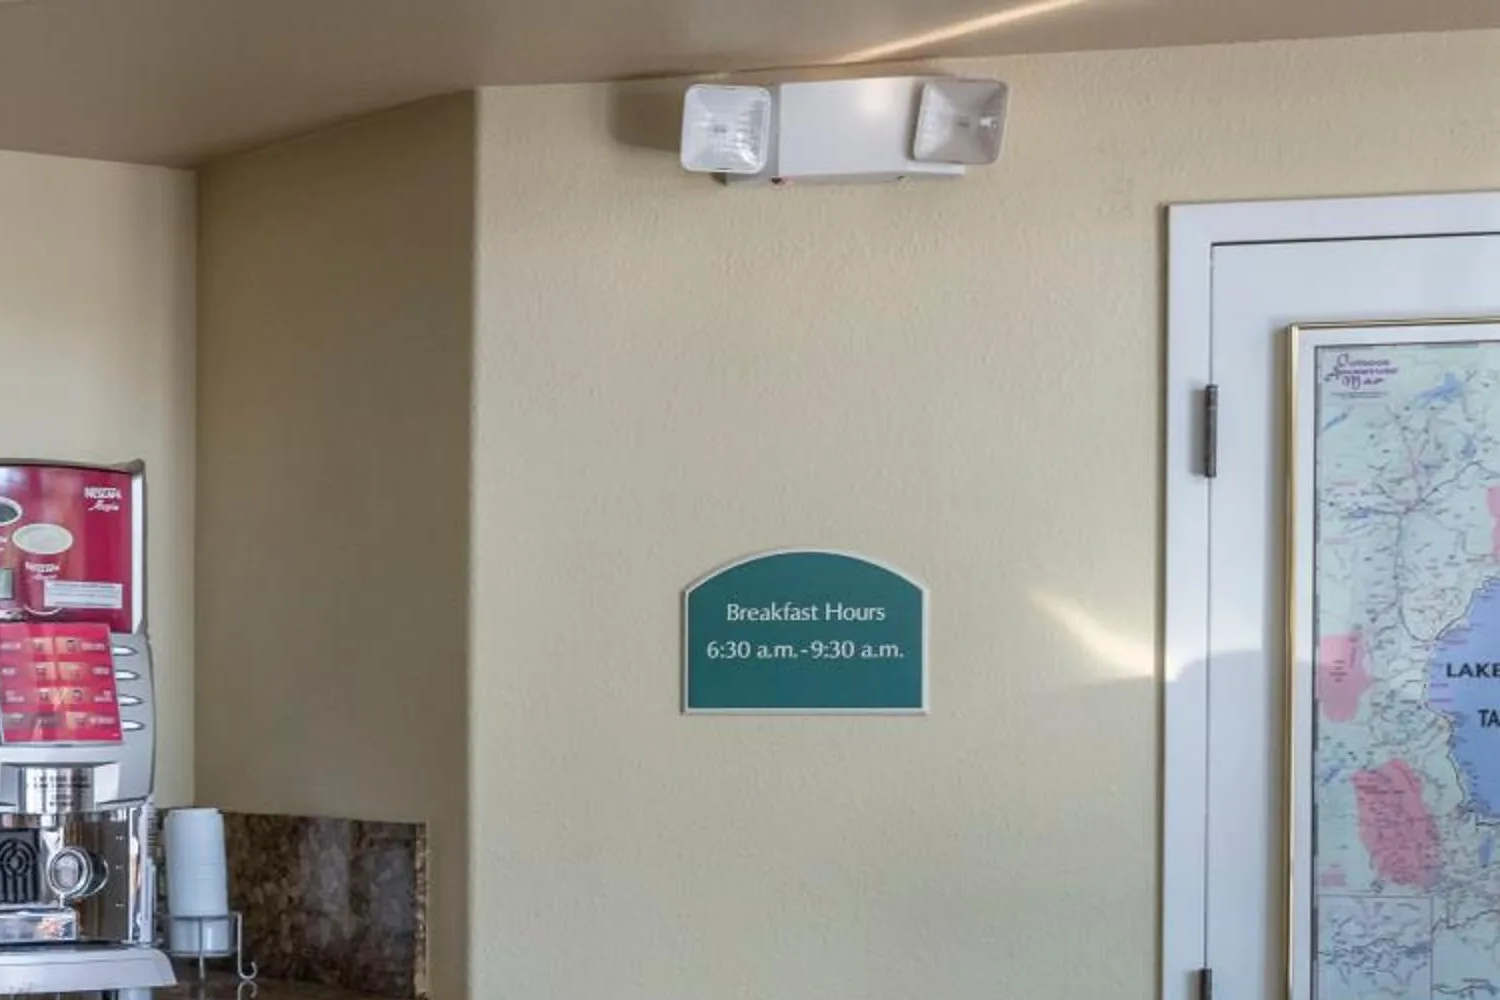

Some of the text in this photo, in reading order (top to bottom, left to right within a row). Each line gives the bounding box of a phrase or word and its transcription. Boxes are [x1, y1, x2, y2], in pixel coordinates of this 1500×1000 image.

[727, 601, 886, 621] Breakfast Hours
[707, 640, 751, 659] 6:30
[860, 643, 904, 658] a.m.
[1446, 662, 1500, 679] LAKE
